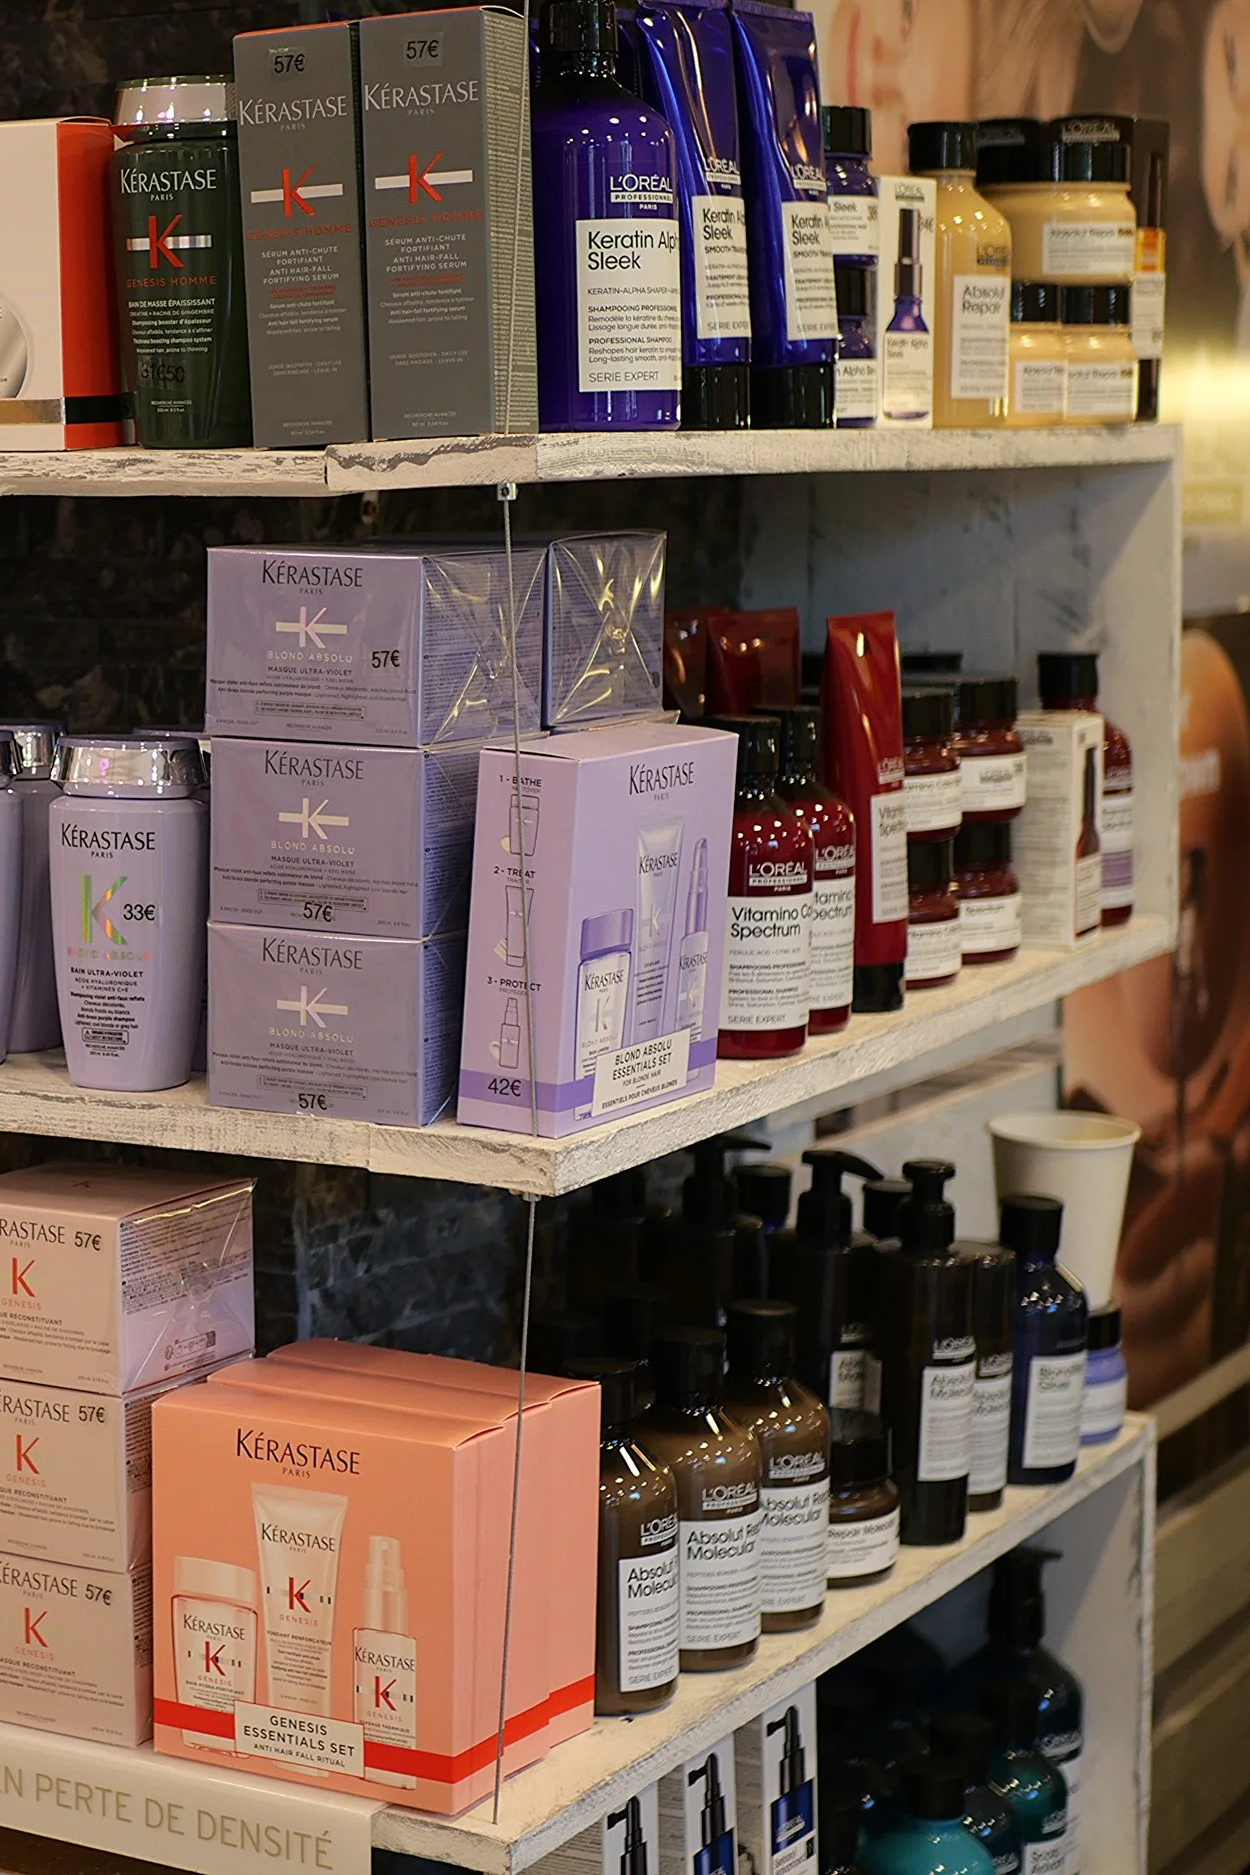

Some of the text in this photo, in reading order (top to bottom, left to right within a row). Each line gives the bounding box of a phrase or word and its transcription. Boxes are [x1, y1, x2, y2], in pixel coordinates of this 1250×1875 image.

[407, 40, 438, 58] 57€
[274, 53, 305, 73] 57€
[365, 81, 478, 110] KÉRASTASE
[240, 97, 347, 126] KÉRASTASE
[121, 168, 216, 193] KÉRASTASE
[611, 174, 672, 192] L'ORÉAL
[149, 214, 184, 269] K
[386, 234, 466, 245] SÉRUM ANTI-CHUTE
[588, 231, 654, 250] Keratin
[703, 225, 732, 240] Sleek
[401, 243, 451, 252] FORTIFIANT
[387, 261, 467, 272] FORTIFYING SERUM
[417, 254, 459, 262] HAIR-FALL
[588, 252, 641, 270] Sleek
[171, 276, 216, 286] HOMME
[263, 560, 363, 587] KÉRASTASE
[372, 650, 400, 668] 57€
[266, 750, 364, 780] KÉRASTASE
[498, 774, 504, 784] 1
[630, 761, 694, 795] KÉRASTASE
[62, 823, 156, 850] KÉRASTASE
[271, 841, 354, 854] BLOND ABSOLU
[272, 856, 354, 868] MASQUE ULTRA-VIOLET
[493, 866, 500, 875] 2
[640, 853, 678, 876] KÉRASTASE
[750, 861, 807, 877] L'ORÉAL
[123, 904, 155, 921] 33€
[303, 902, 332, 922] 57€
[732, 907, 798, 922] Vitamino
[731, 923, 801, 940] Spectrum
[263, 938, 362, 970] KÉRASTASE
[486, 976, 493, 985] 3
[585, 973, 624, 991] KÉRASTASE
[615, 1039, 673, 1066] BLOND ABSOLU
[612, 1052, 672, 1080] ESSENTIALS SET
[488, 1079, 522, 1096] 42€
[298, 1094, 327, 1110] 57€
[75, 1231, 102, 1250] 57€
[78, 1406, 105, 1423] 57€
[236, 1428, 360, 1475] KÉRASTASE
[262, 1523, 335, 1552] KÉRASTASE
[85, 1584, 112, 1604] 57€
[183, 1614, 245, 1640] KÉRASTASE
[355, 1647, 415, 1671] KÉRASTASE
[270, 1715, 327, 1735] GENESIS
[244, 1726, 354, 1756] ESSENTIALS SET
[317, 1755, 345, 1767] RITUAL
[35, 1773, 132, 1825] PERTE
[145, 1801, 185, 1834] DE
[196, 1809, 333, 1869] DENSITÉ
